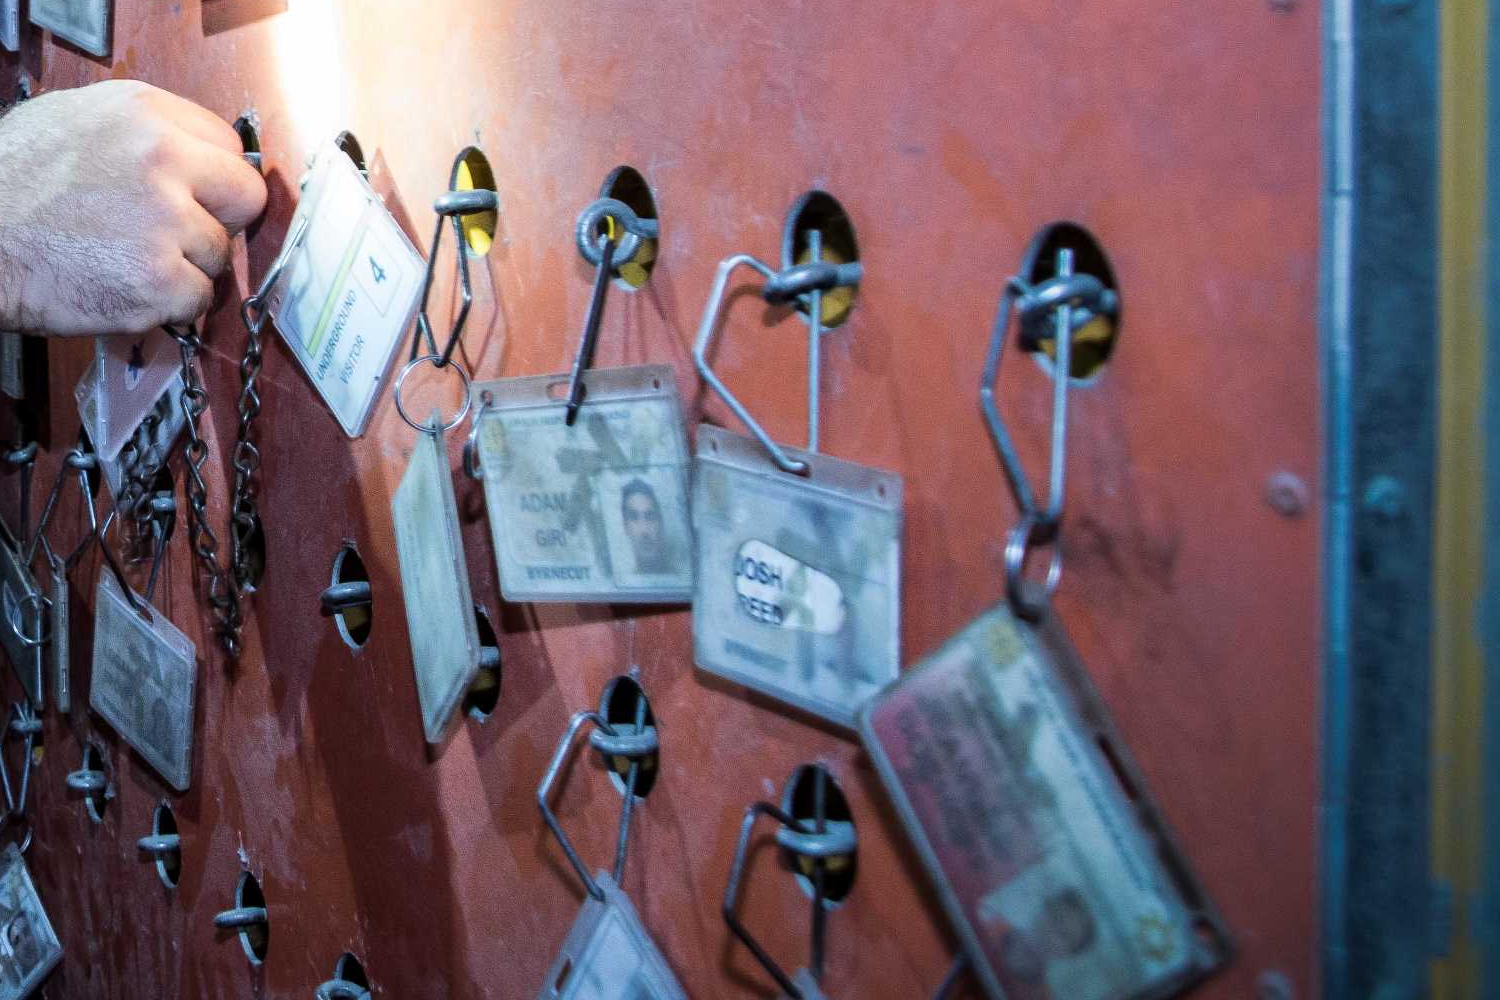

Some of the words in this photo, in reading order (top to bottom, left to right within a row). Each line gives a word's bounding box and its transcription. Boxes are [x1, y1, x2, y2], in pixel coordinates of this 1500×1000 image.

[370, 256, 387, 283] 4
[316, 289, 357, 381] UNDERGROUND
[340, 333, 365, 385] VISITOR
[735, 557, 784, 590] JOSH
